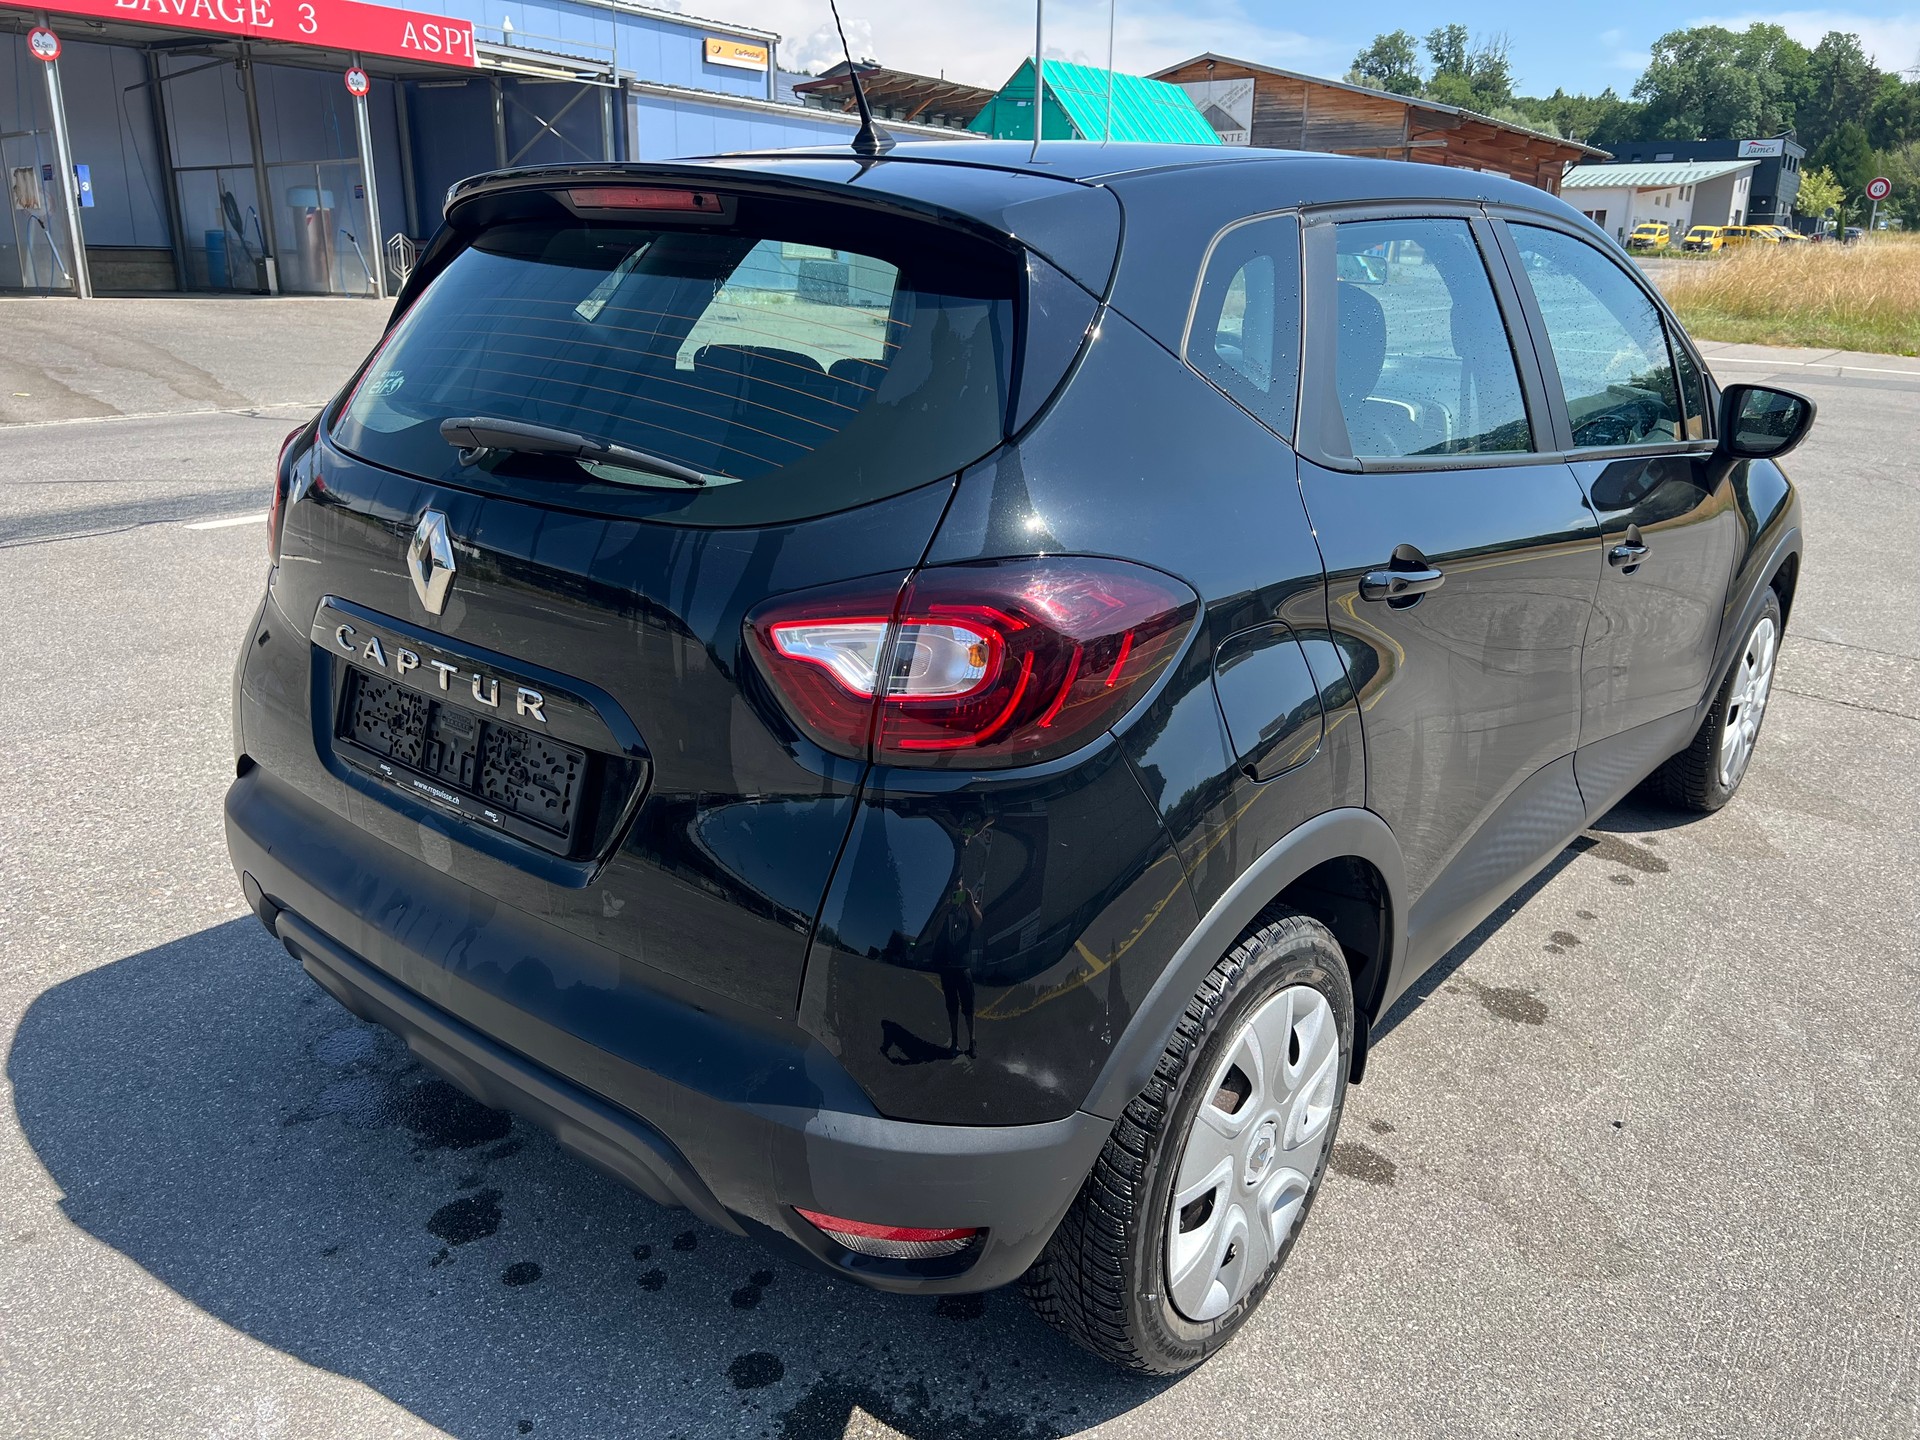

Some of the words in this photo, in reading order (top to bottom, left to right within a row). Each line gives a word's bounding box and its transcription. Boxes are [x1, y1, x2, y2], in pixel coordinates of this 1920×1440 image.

[114, 0, 274, 28] VAGE
[297, 3, 319, 34] 3
[400, 21, 473, 58] ASPI
[1218, 133, 1243, 142] NTE
[1745, 145, 1776, 155] James
[81, 181, 90, 192] 3
[1873, 184, 1884, 193] 60
[335, 624, 547, 723] CAPTUR
[413, 779, 461, 806] www.rrgsuisse.ch
